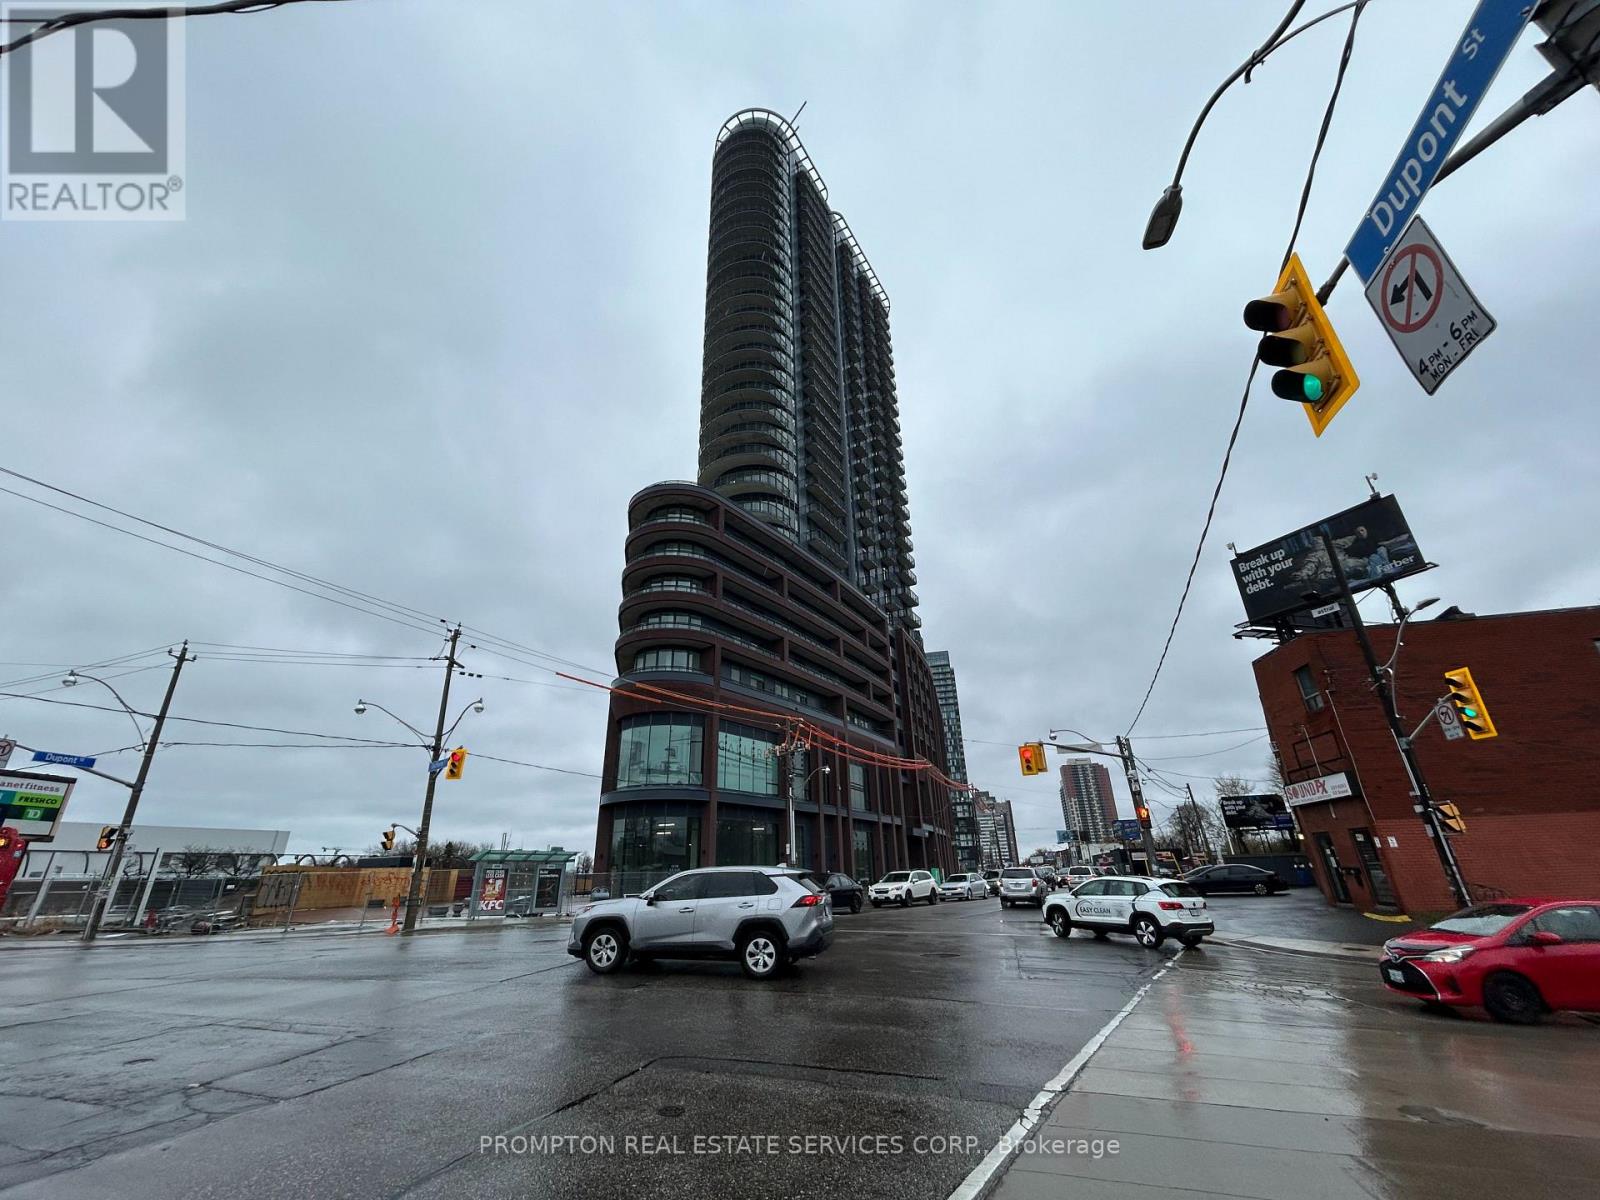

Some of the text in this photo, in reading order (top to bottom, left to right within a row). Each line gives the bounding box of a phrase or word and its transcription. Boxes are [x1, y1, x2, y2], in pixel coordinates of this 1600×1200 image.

[1371, 26, 1485, 237] Dupont St
[1238, 549, 1286, 573] Break up
[1376, 554, 1415, 573] Farber
[1242, 557, 1293, 584] with your
[1246, 581, 1275, 595] debt.
[1317, 605, 1335, 615] astral
[45, 753, 77, 763] Dupont
[480, 900, 504, 910] KFC
